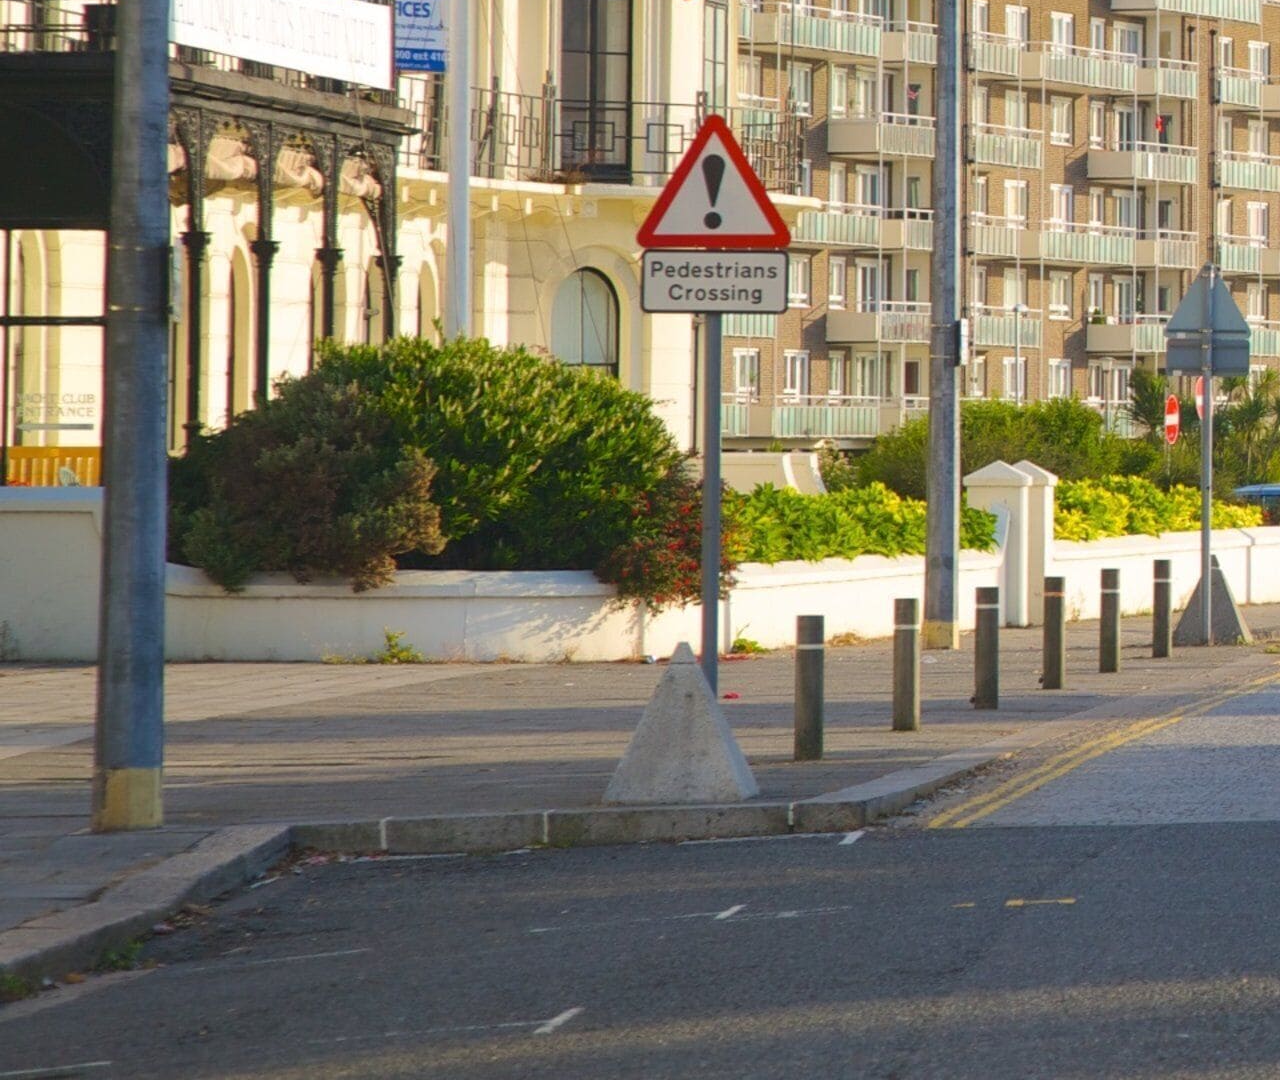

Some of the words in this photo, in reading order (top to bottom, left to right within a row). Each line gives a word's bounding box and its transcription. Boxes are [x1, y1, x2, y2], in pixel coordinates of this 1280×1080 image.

[650, 261, 778, 279] Pedestrians
[668, 284, 763, 305] Crossing
[62, 393, 96, 404] CLUB
